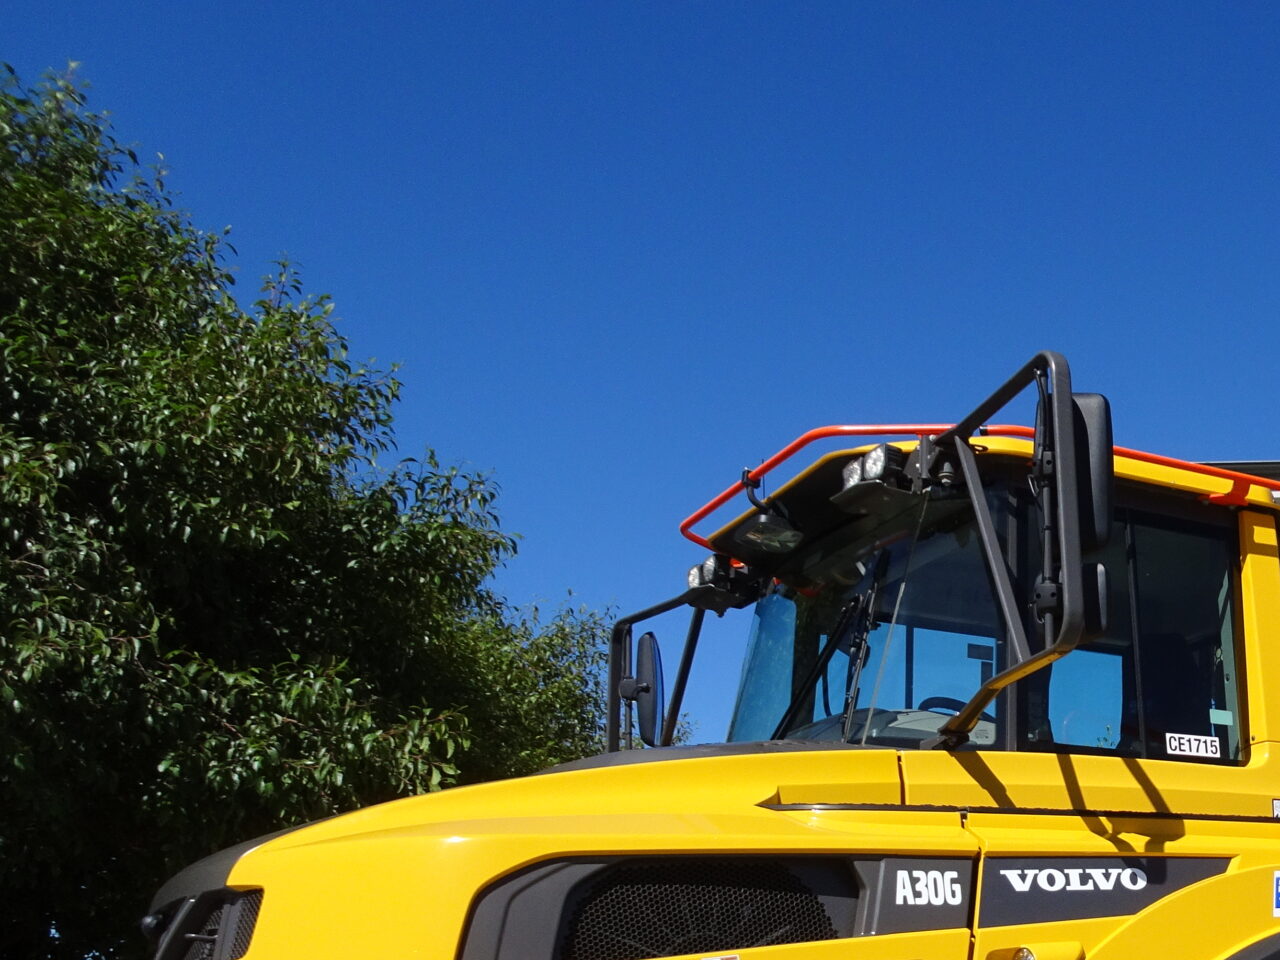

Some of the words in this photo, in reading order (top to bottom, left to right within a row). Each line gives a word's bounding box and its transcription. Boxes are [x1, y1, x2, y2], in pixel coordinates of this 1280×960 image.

[1168, 735, 1218, 755] CE1715
[895, 870, 962, 905] A30G
[1000, 868, 1147, 892] VOLVO
